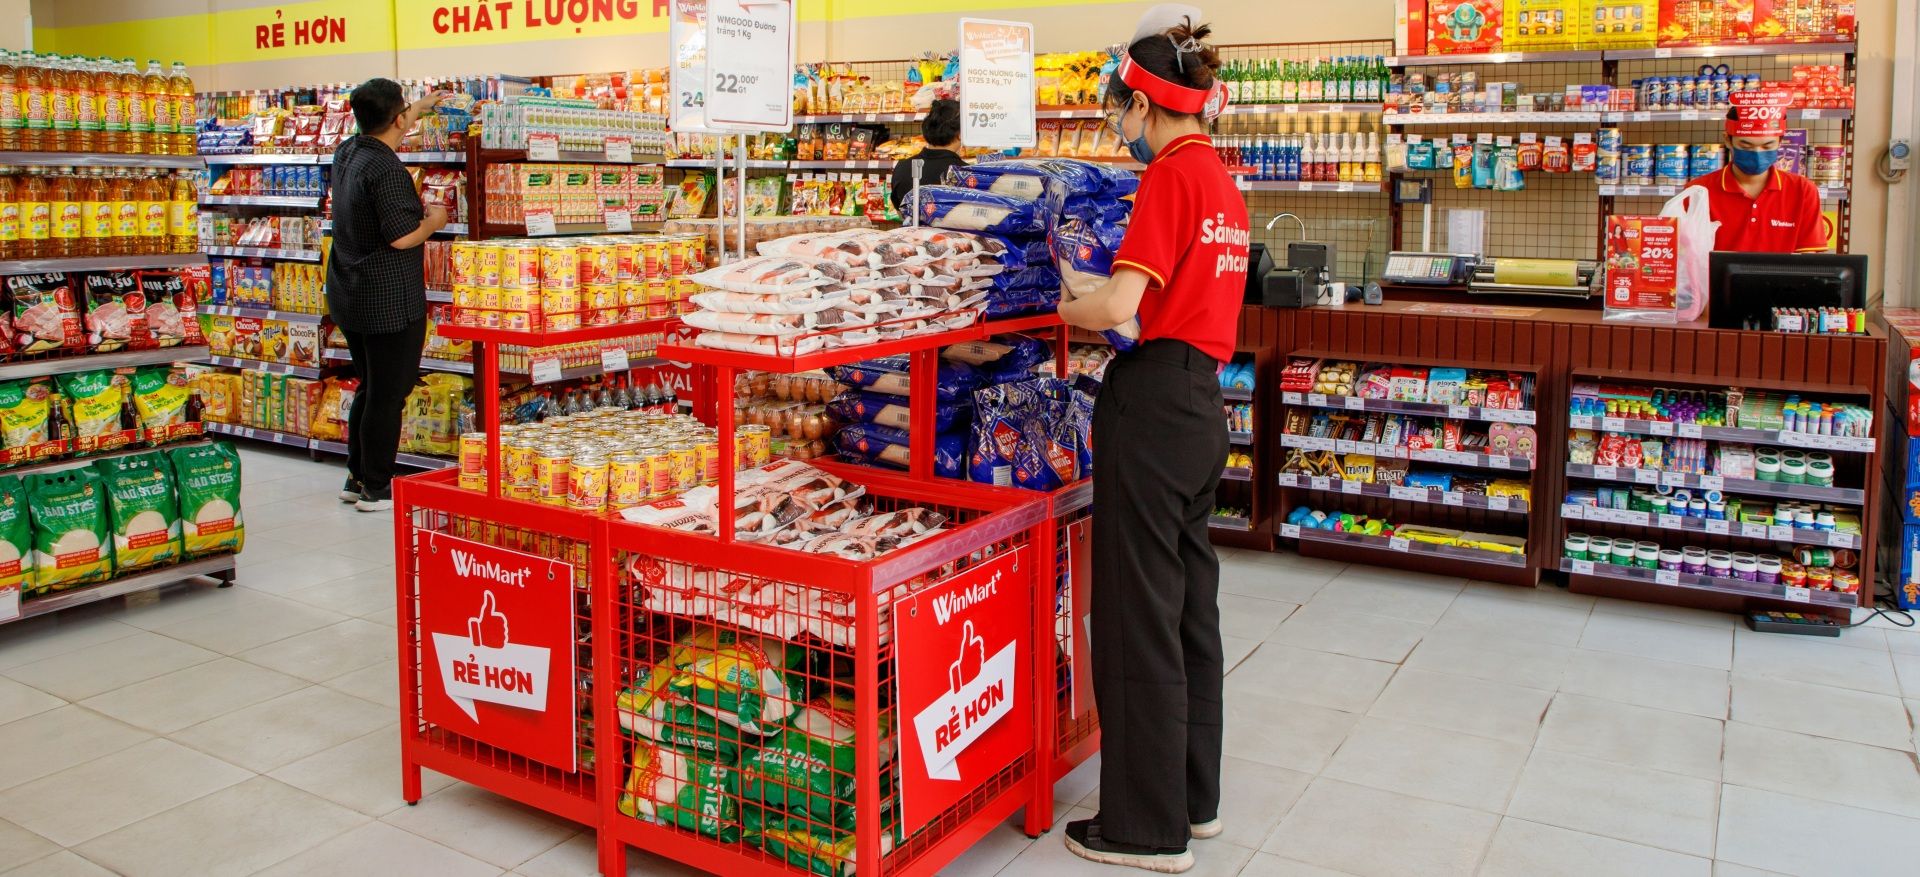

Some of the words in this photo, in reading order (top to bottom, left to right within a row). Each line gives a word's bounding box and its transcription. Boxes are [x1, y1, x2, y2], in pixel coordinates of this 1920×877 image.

[717, 15, 753, 28] WMGOOD
[256, 10, 285, 49] RẺ
[294, 15, 346, 45] HƠN
[742, 31, 752, 41] Kg
[1748, 107, 1782, 120] 20%
[1641, 247, 1674, 259] 20%
[8, 272, 65, 289] CHIN-SU
[87, 275, 134, 291] CHIN-SU
[235, 321, 260, 331] ChocoPie
[290, 328, 316, 338] ChocoPie
[209, 472, 233, 485] ST25
[138, 483, 165, 497] ST25
[453, 653, 480, 686] RẺ
[484, 666, 533, 695] HƠN
[934, 705, 961, 753] RẺ
[965, 678, 1005, 731] HƠN
